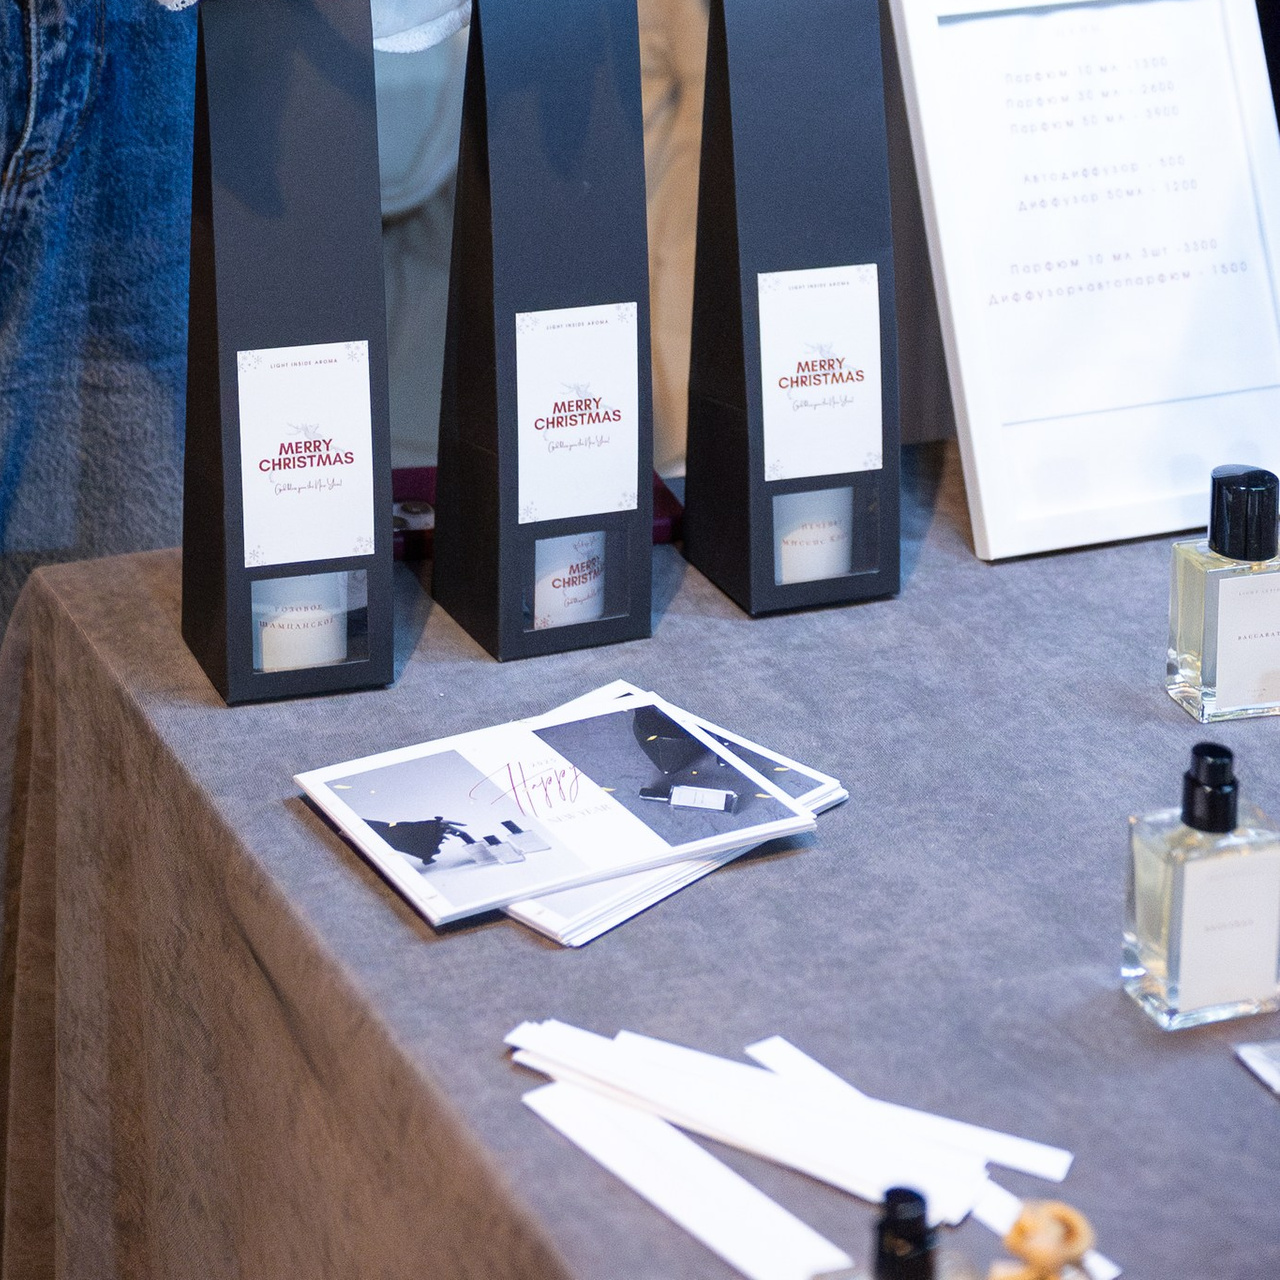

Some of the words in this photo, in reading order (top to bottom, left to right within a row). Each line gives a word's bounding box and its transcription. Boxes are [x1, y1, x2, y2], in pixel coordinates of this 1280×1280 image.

[1078, 63, 1092, 76] 10
[1018, 193, 1099, 212] Диффузор
[1010, 259, 1079, 275] Парфюм
[1088, 252, 1103, 265] 10
[270, 362, 289, 370] LIGHT
[796, 357, 846, 374] MERRY
[778, 370, 865, 389] CHRISTMAS
[553, 397, 603, 414] MERRY
[534, 409, 622, 431] CHRISTMAS
[278, 438, 333, 456] MERRY
[259, 451, 355, 472] CHRISTMAS
[469, 761, 583, 818] Happy
